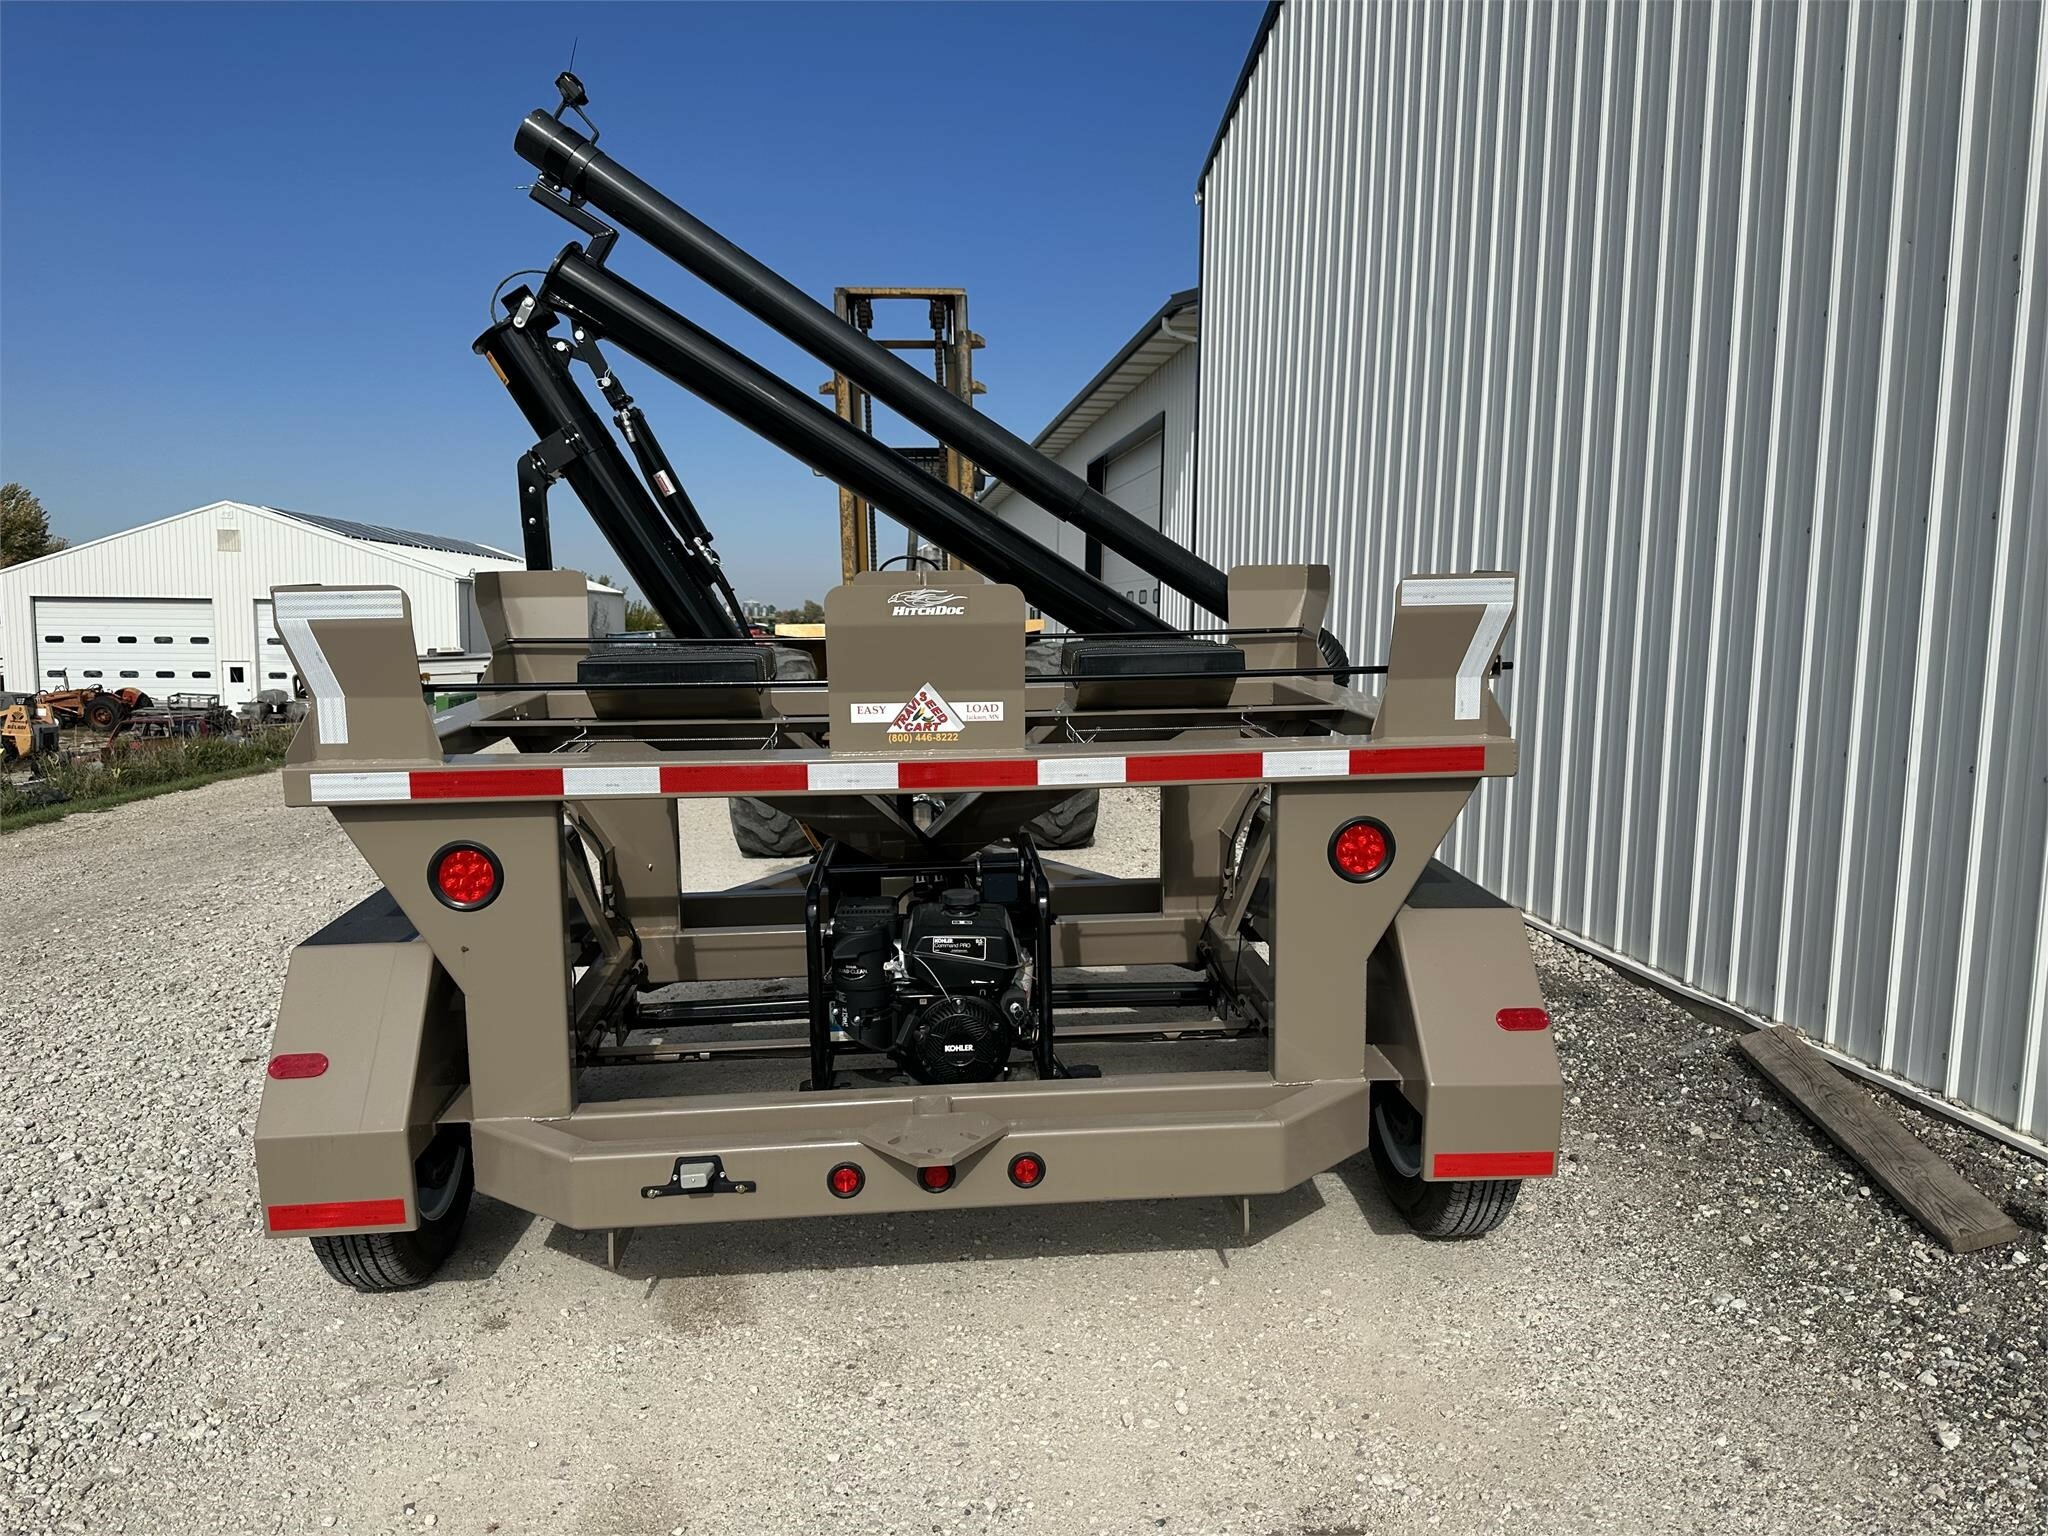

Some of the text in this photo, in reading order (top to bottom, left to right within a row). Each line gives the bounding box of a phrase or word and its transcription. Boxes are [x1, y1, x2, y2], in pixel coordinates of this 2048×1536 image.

[856, 705, 887, 715] EASY
[966, 703, 999, 713] LOAD
[904, 722, 941, 732] CART
[888, 733, 959, 743] (800) 446-8222
[944, 1044, 974, 1052] KOHLER
